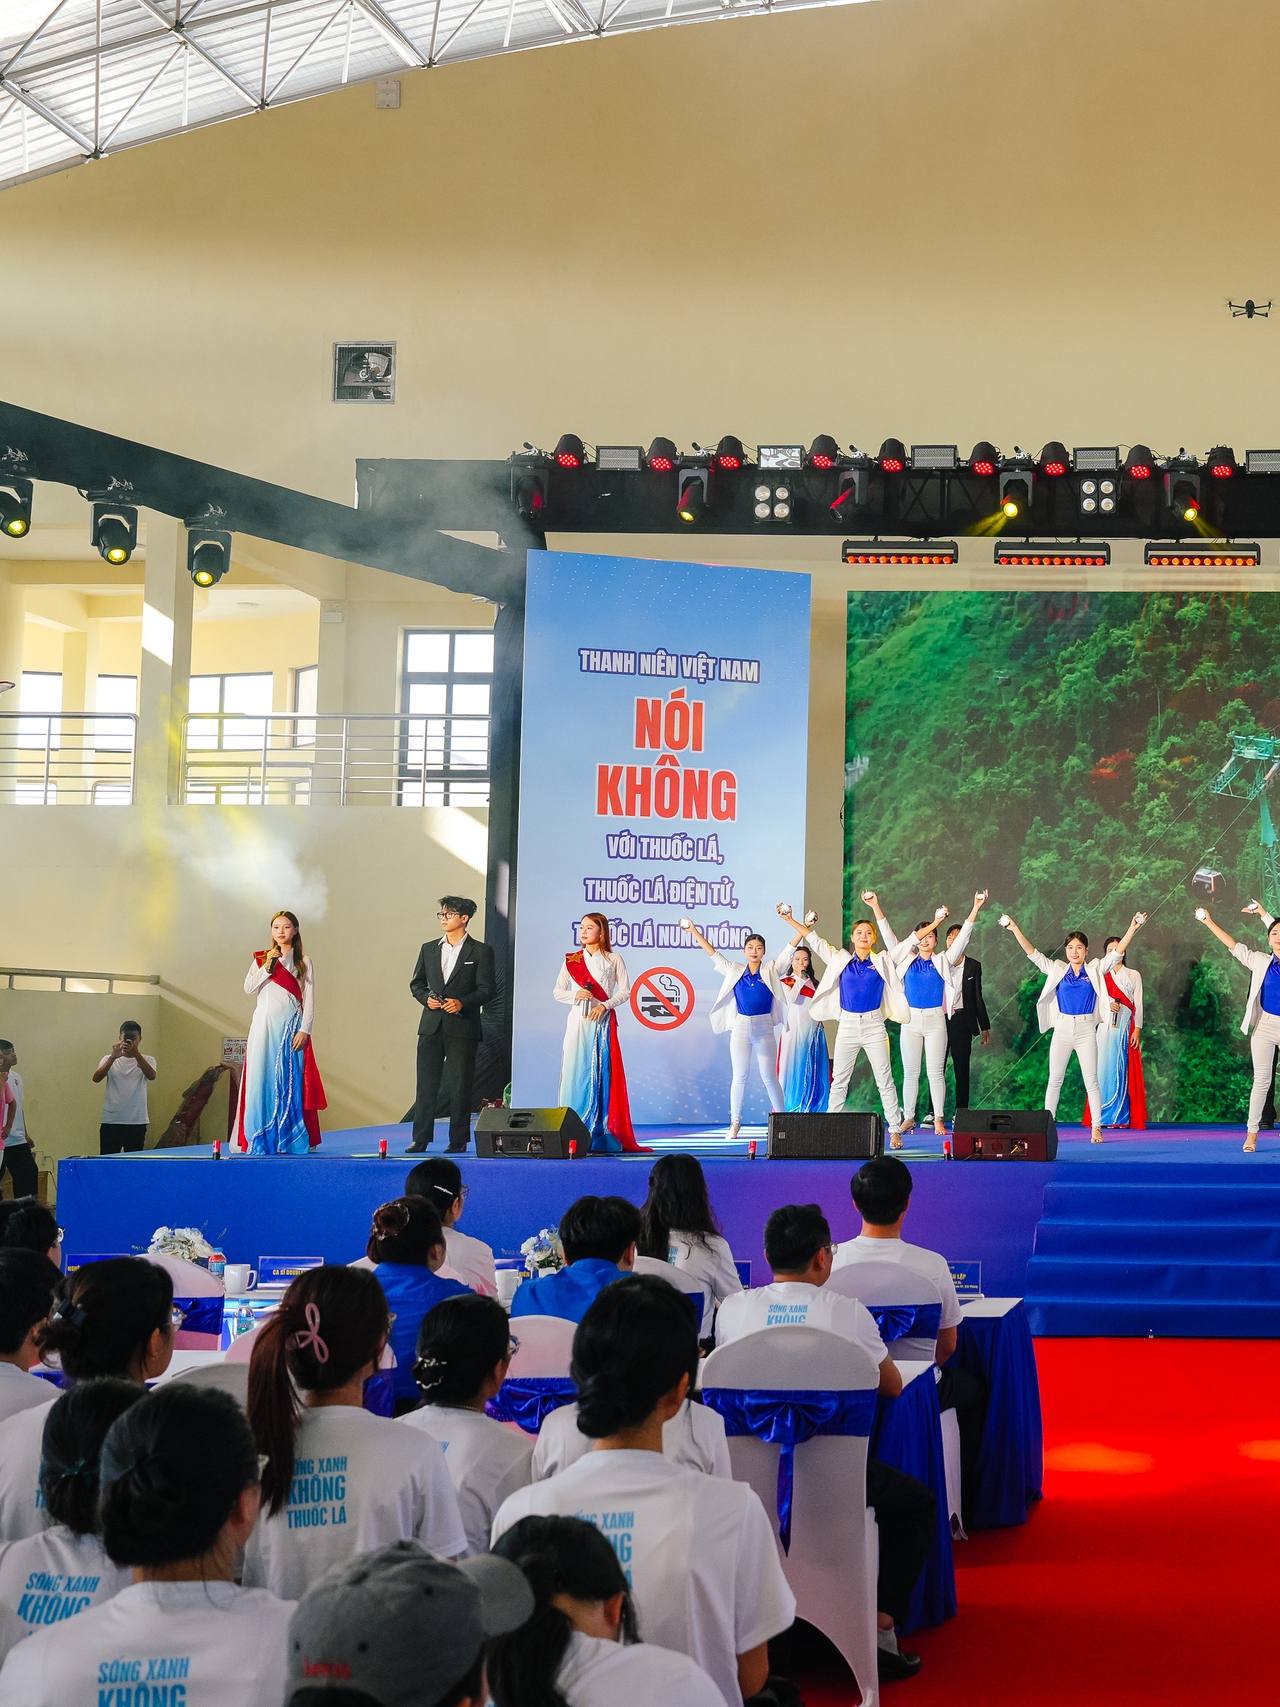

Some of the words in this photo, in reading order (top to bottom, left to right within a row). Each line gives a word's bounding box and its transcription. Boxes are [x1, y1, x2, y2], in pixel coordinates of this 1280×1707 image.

[579, 649, 635, 675] THANH
[639, 649, 678, 677] NIÊN
[680, 653, 717, 683] VIỆT
[720, 658, 759, 683] NAM
[635, 687, 704, 752] NÓI
[597, 754, 737, 821] KHÔNG
[607, 830, 636, 858] VỚI
[639, 833, 694, 860] THUỐC
[697, 834, 724, 864] LÁ,
[585, 875, 640, 902] THUỐC
[644, 876, 665, 903] LÁ
[669, 878, 707, 908] ĐIỆN
[711, 877, 738, 908] TỬ,
[573, 919, 629, 947] TỐC
[633, 920, 654, 947] LÁ
[318, 1456, 348, 1473] XANH
[286, 1503, 328, 1529] THUỐC
[331, 1501, 347, 1525] LÁ
[601, 1511, 635, 1530] XANH
[63, 1576, 102, 1593] XANH
[97, 1655, 142, 1684] SỐNG
[145, 1656, 190, 1681] XANH
